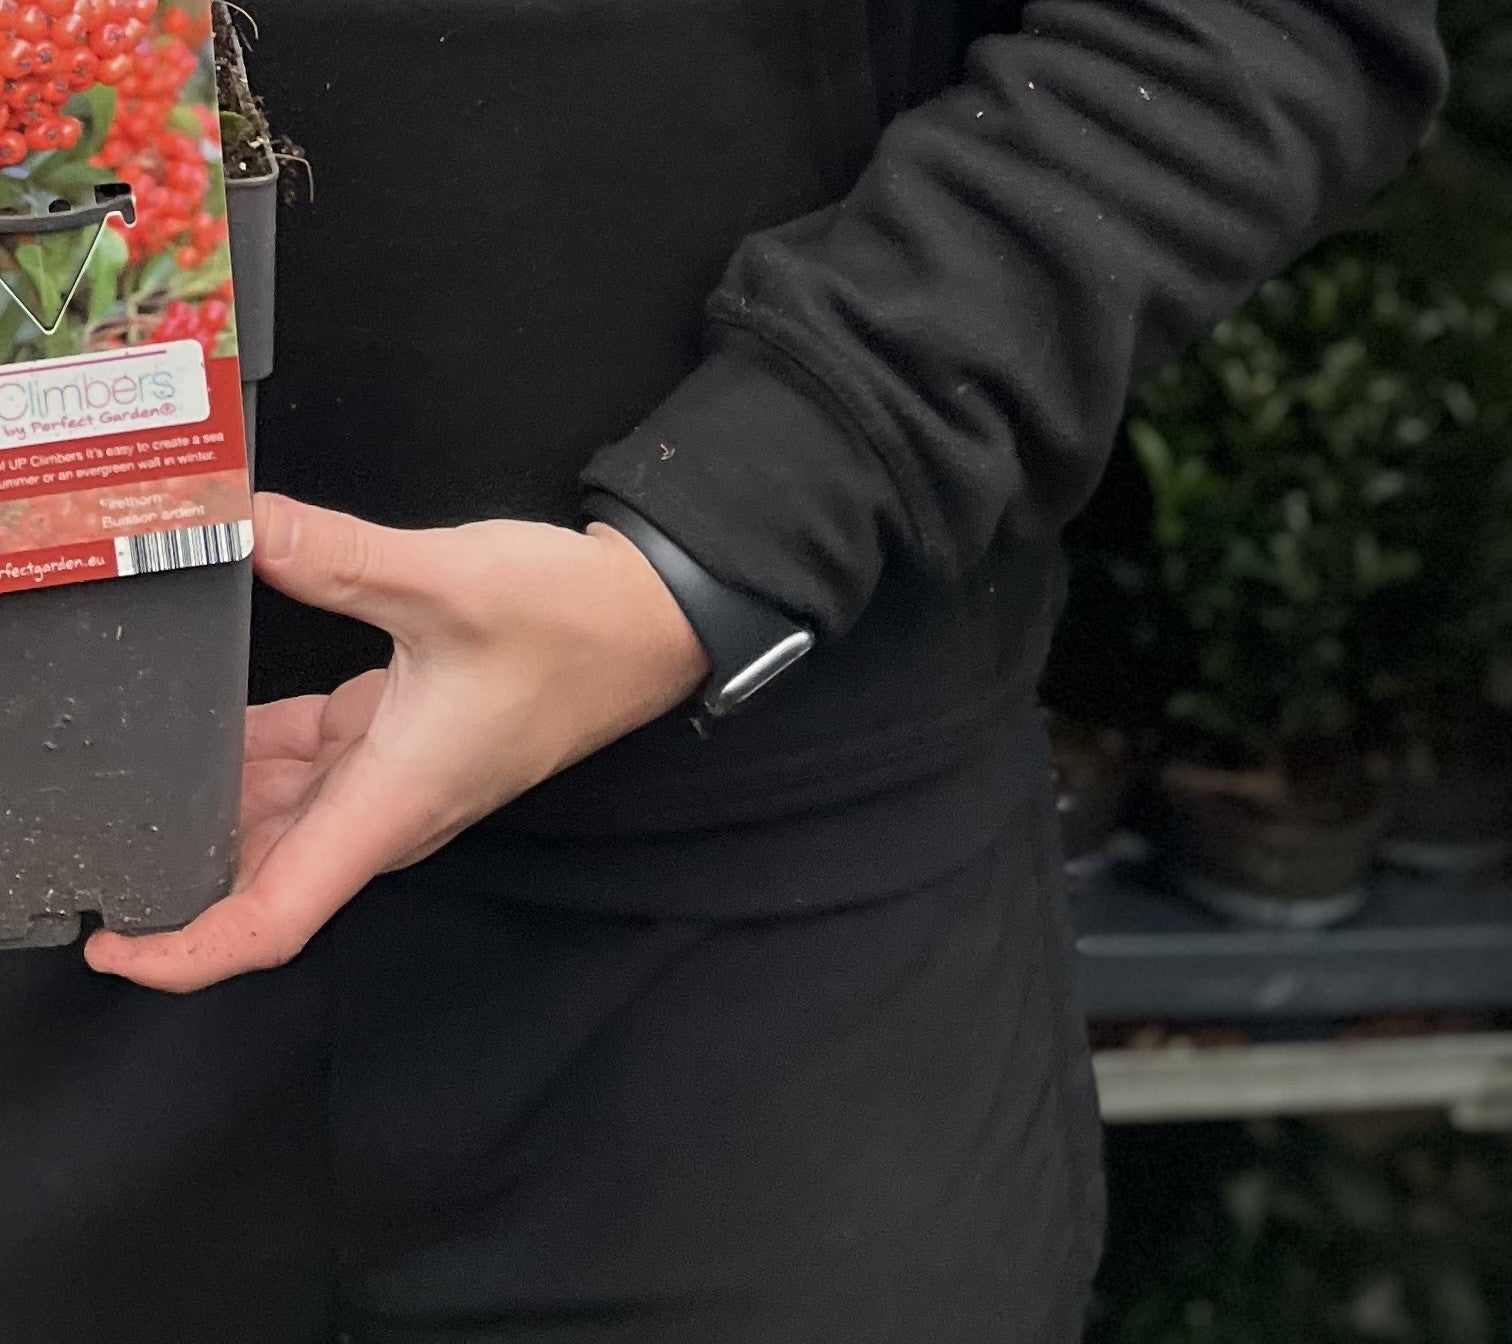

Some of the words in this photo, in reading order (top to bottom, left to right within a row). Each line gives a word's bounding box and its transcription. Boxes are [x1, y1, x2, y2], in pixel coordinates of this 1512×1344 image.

[4, 424, 26, 440] by
[31, 416, 94, 433] Perfect
[8, 458, 27, 470] UP
[29, 452, 83, 468] Climbers
[105, 445, 134, 457] easy
[136, 441, 150, 453] to
[151, 437, 189, 451] create
[191, 435, 200, 445] a
[42, 472, 55, 484] or
[58, 470, 73, 481] an
[76, 462, 135, 478] evergreen
[138, 457, 161, 470] wall
[163, 456, 175, 466] in
